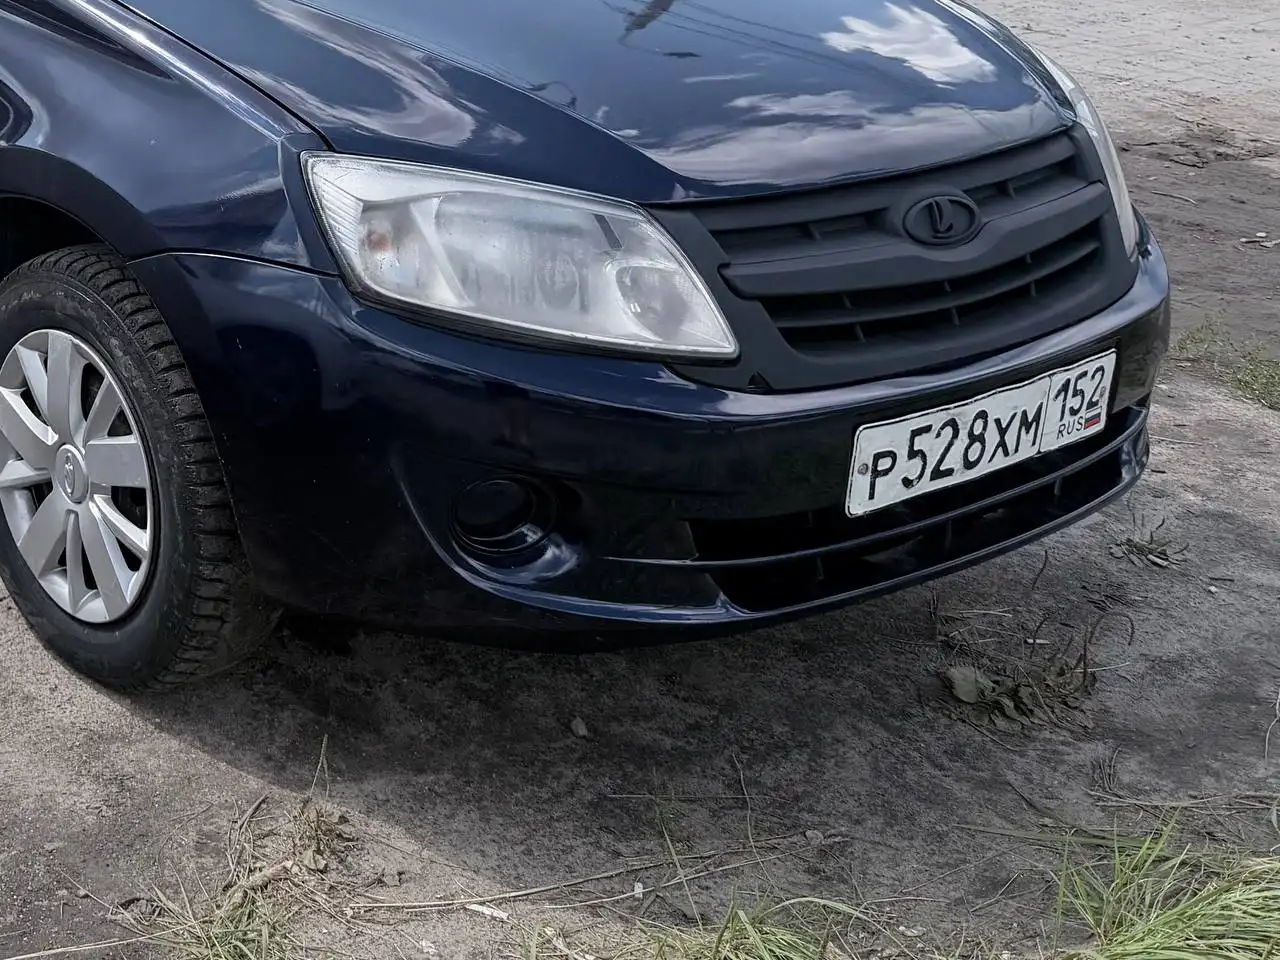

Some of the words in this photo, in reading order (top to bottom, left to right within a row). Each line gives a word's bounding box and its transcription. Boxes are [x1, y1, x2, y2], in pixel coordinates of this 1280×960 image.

[868, 401, 1043, 500] Р528ХМ
[1053, 364, 1106, 422] 152
[1056, 418, 1085, 440] RUS
